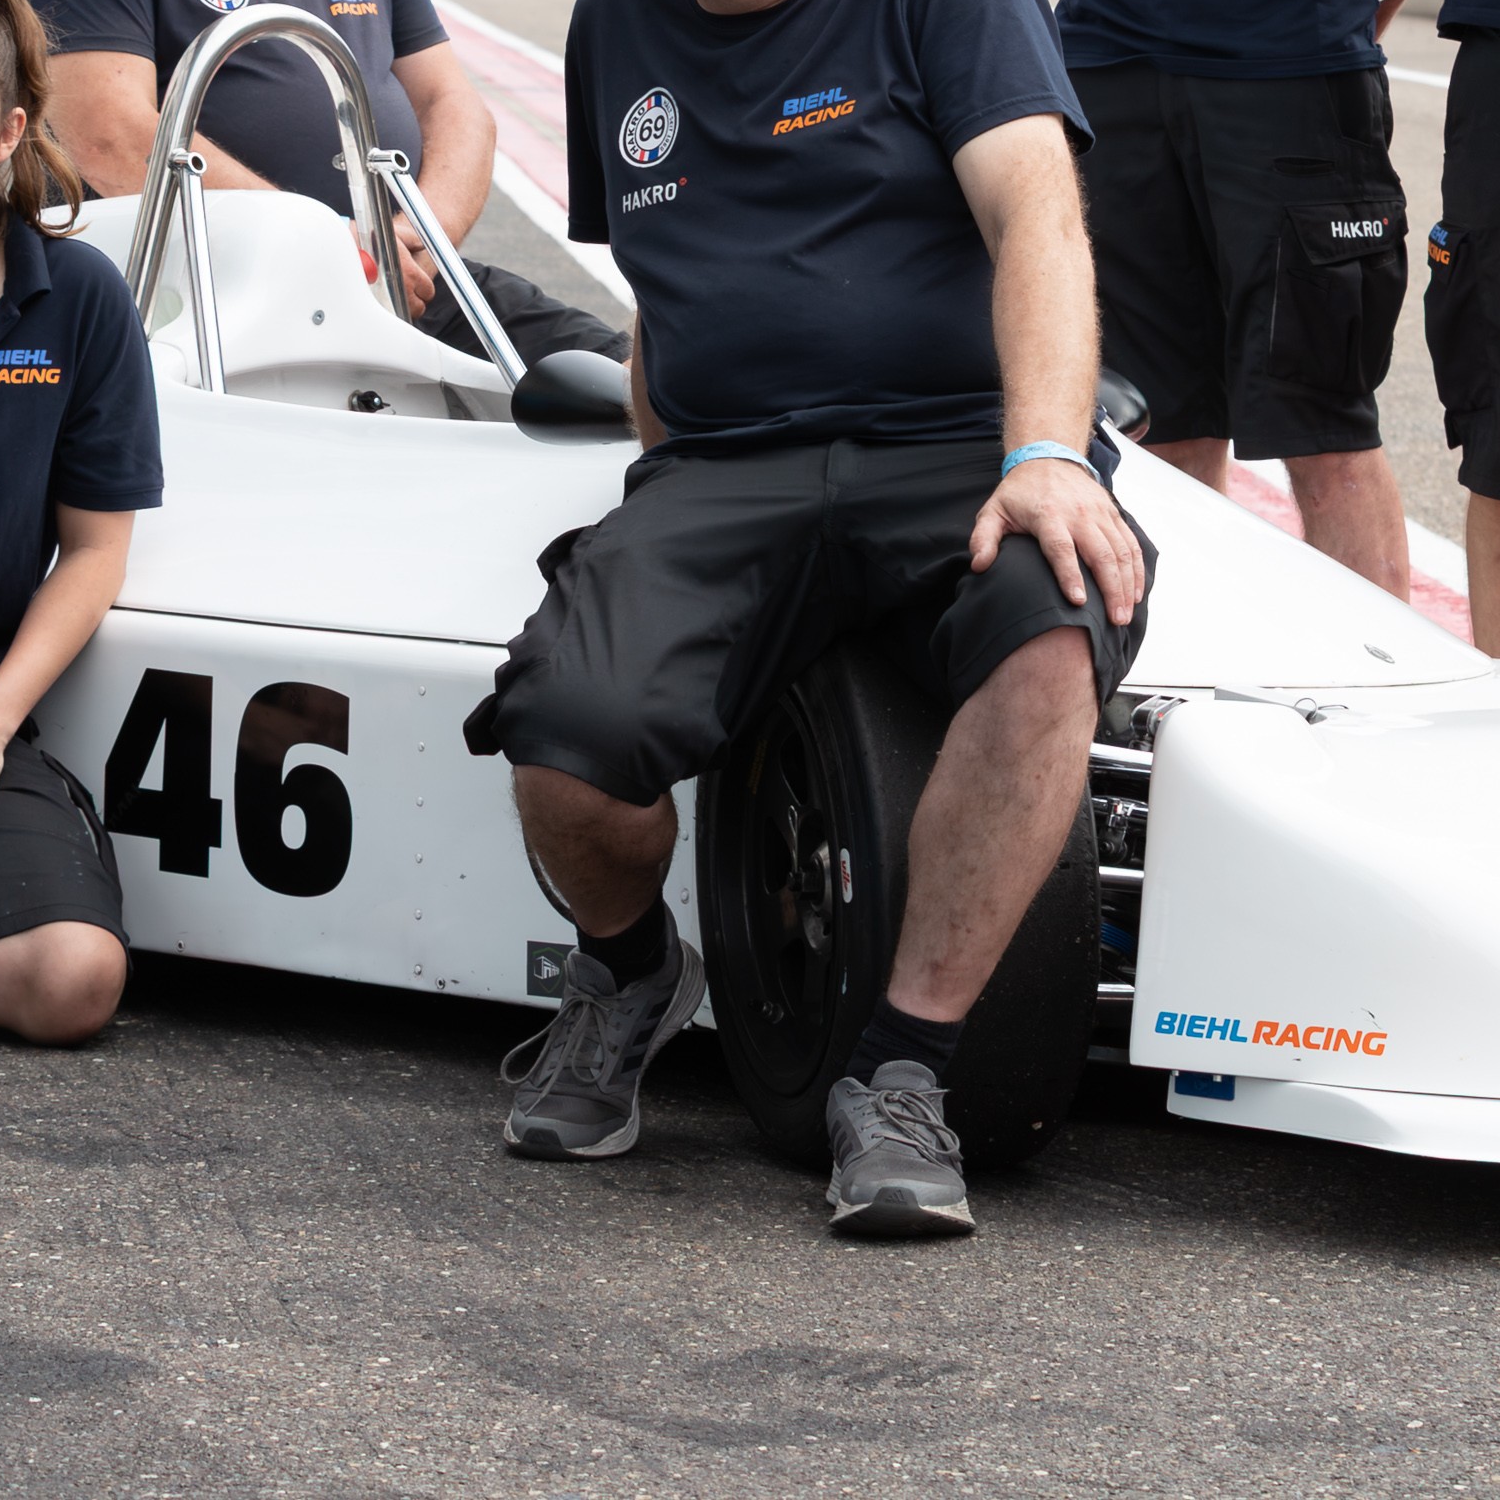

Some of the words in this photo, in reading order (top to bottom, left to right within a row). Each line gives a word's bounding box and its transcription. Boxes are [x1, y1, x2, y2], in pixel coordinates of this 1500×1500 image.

[772, 99, 857, 136] RACING
[782, 86, 848, 117] BIEHL
[639, 114, 666, 142] 69
[622, 182, 678, 214] HAKRO
[1330, 220, 1383, 238] HAKRO
[104, 666, 353, 898] 46
[1154, 1011, 1248, 1043] BIEHL
[1251, 1020, 1388, 1056] RACING
